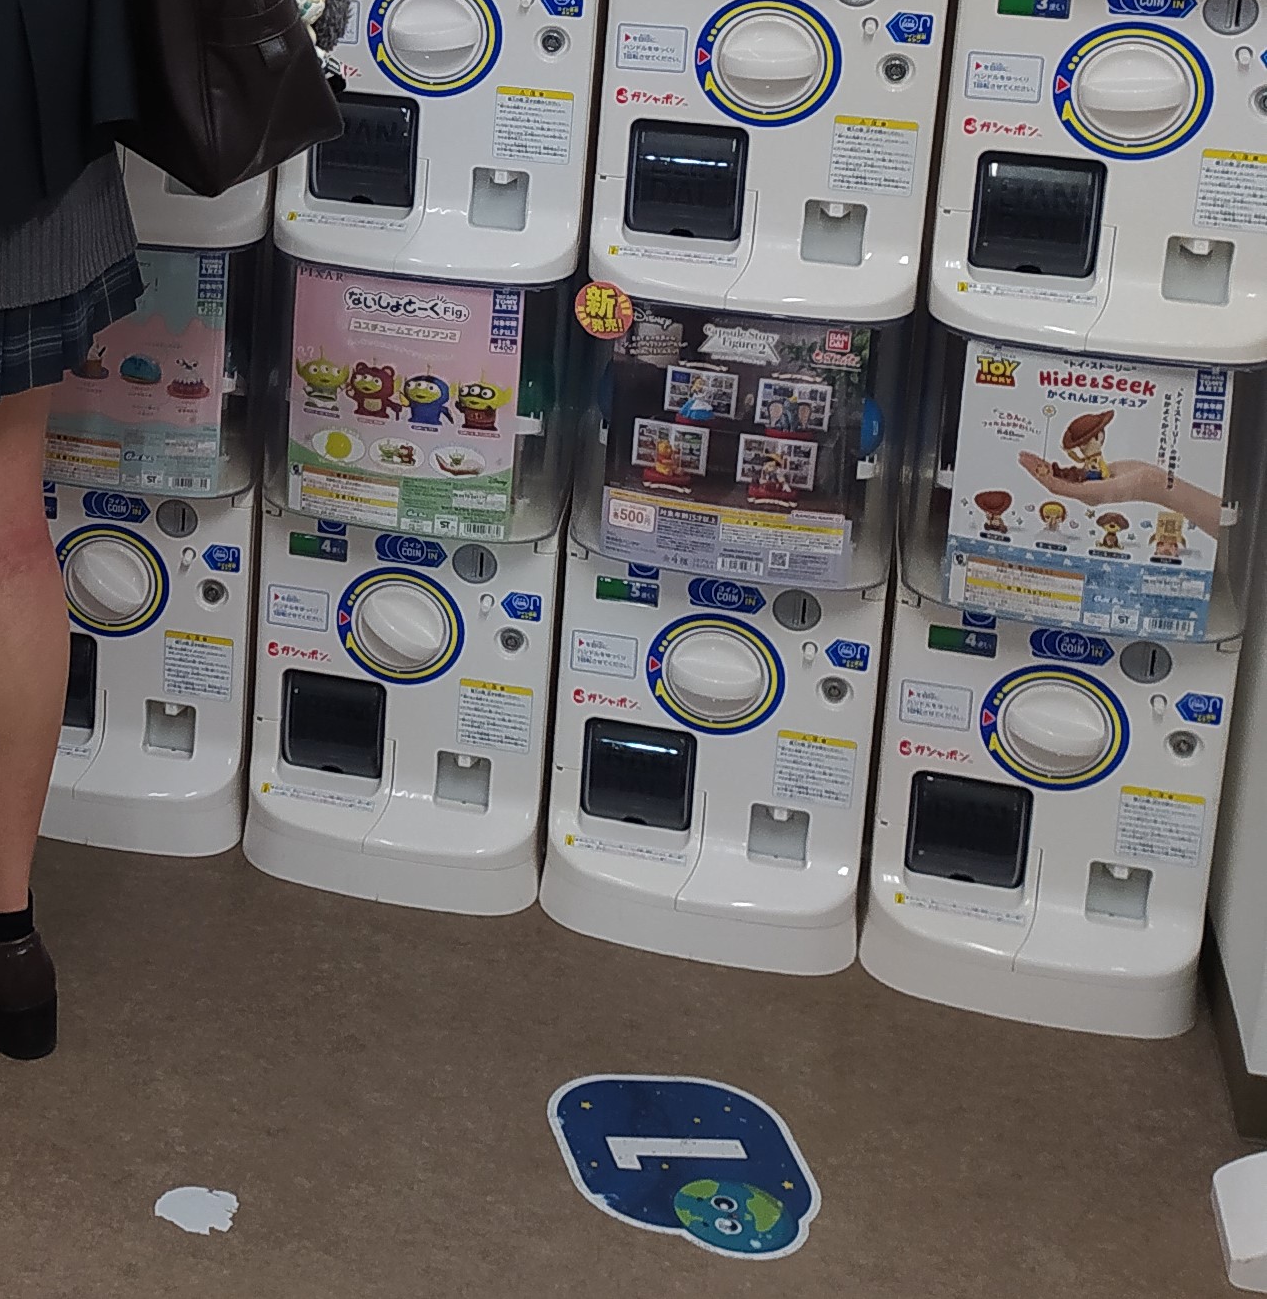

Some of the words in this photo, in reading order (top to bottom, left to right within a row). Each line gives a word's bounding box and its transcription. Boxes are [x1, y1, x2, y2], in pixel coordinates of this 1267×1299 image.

[1172, 0, 1185, 9] IN
[631, 92, 685, 106] ガシャポン
[979, 121, 1037, 137] ガシャポン
[300, 266, 344, 282] PIXAR
[348, 289, 440, 317] ないしょとーく
[444, 306, 467, 320] Fig.
[585, 287, 617, 316] 新
[592, 318, 624, 333] 発売!
[633, 308, 673, 329] Disney
[353, 322, 458, 341] コスチュームエイリアン2
[702, 323, 747, 340] Capsule
[748, 330, 778, 344] Story
[722, 338, 753, 351] Figure
[755, 342, 767, 355] 2
[976, 356, 1022, 377] TOY
[979, 375, 1013, 385] STORY
[1047, 389, 1148, 408] かくれんぼフィギュア
[106, 503, 127, 514] COIN
[321, 539, 332, 553] 4
[401, 547, 422, 558] COIN
[427, 551, 438, 560] IN
[715, 591, 739, 602] COIN
[965, 632, 977, 647] 4
[281, 646, 328, 662] ガシャポン
[1059, 642, 1086, 655] COIN
[587, 693, 640, 710] ガシャポン
[914, 744, 971, 763] ガシャポン
[605, 1135, 748, 1171] 1
